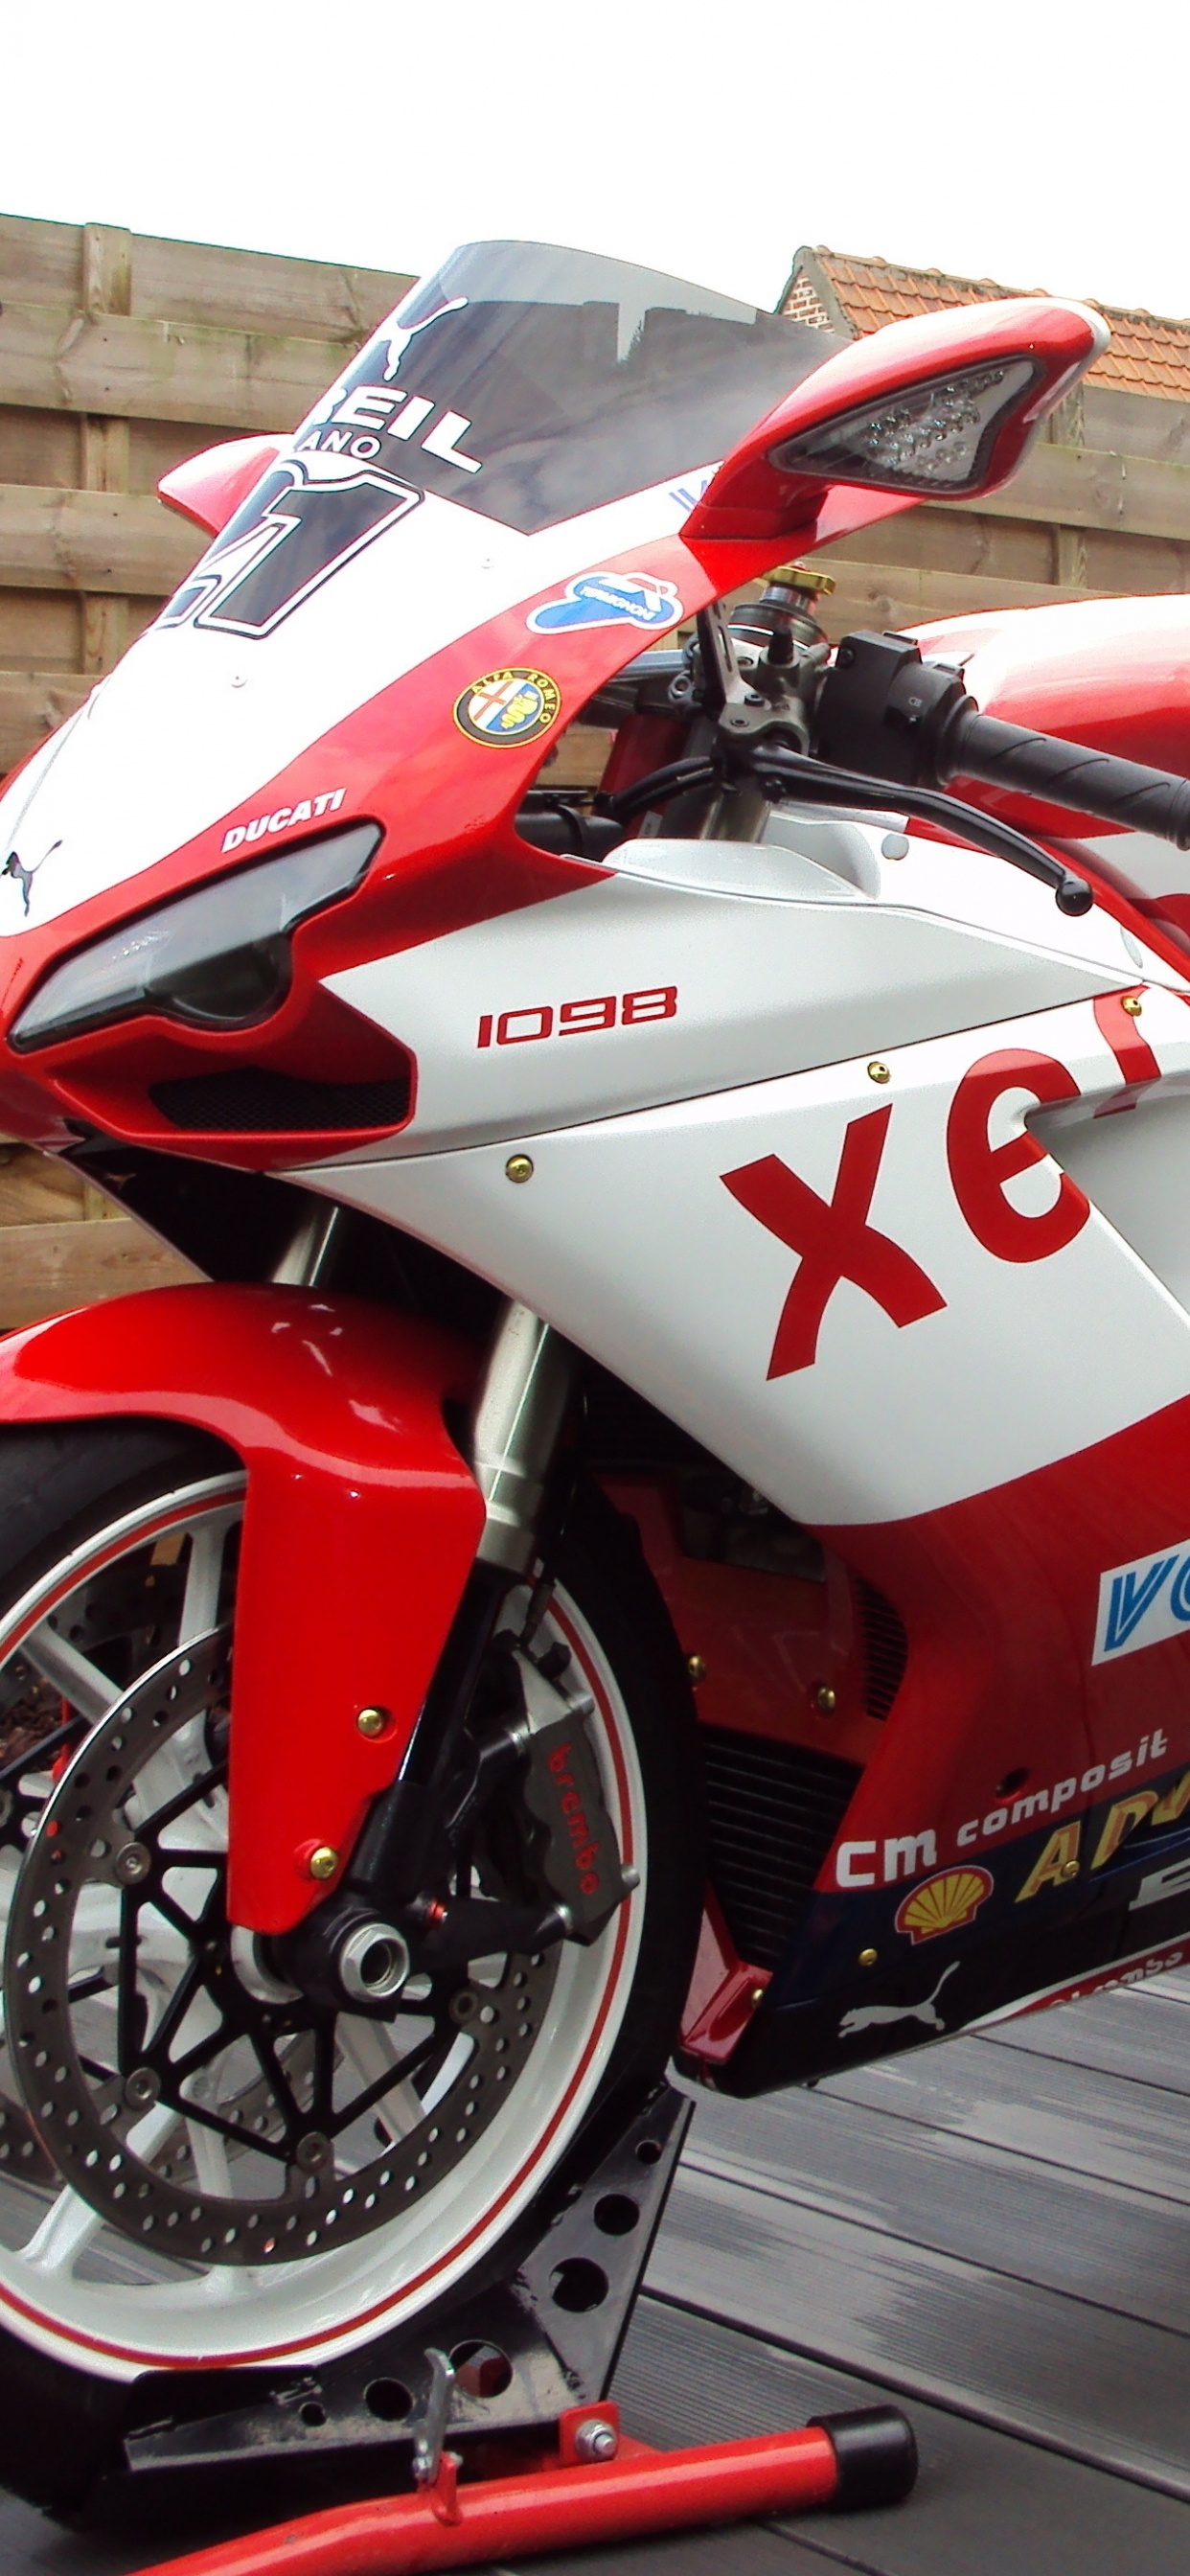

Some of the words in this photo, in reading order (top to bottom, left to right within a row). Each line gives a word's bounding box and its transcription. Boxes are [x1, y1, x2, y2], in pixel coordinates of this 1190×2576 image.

[471, 672, 514, 694] ALFA
[527, 673, 556, 724] ROMEO
[220, 788, 347, 854] DUCATI
[477, 986, 678, 1048] 1098
[548, 1742, 600, 1895] brembo
[956, 1729, 1169, 1847] composit
